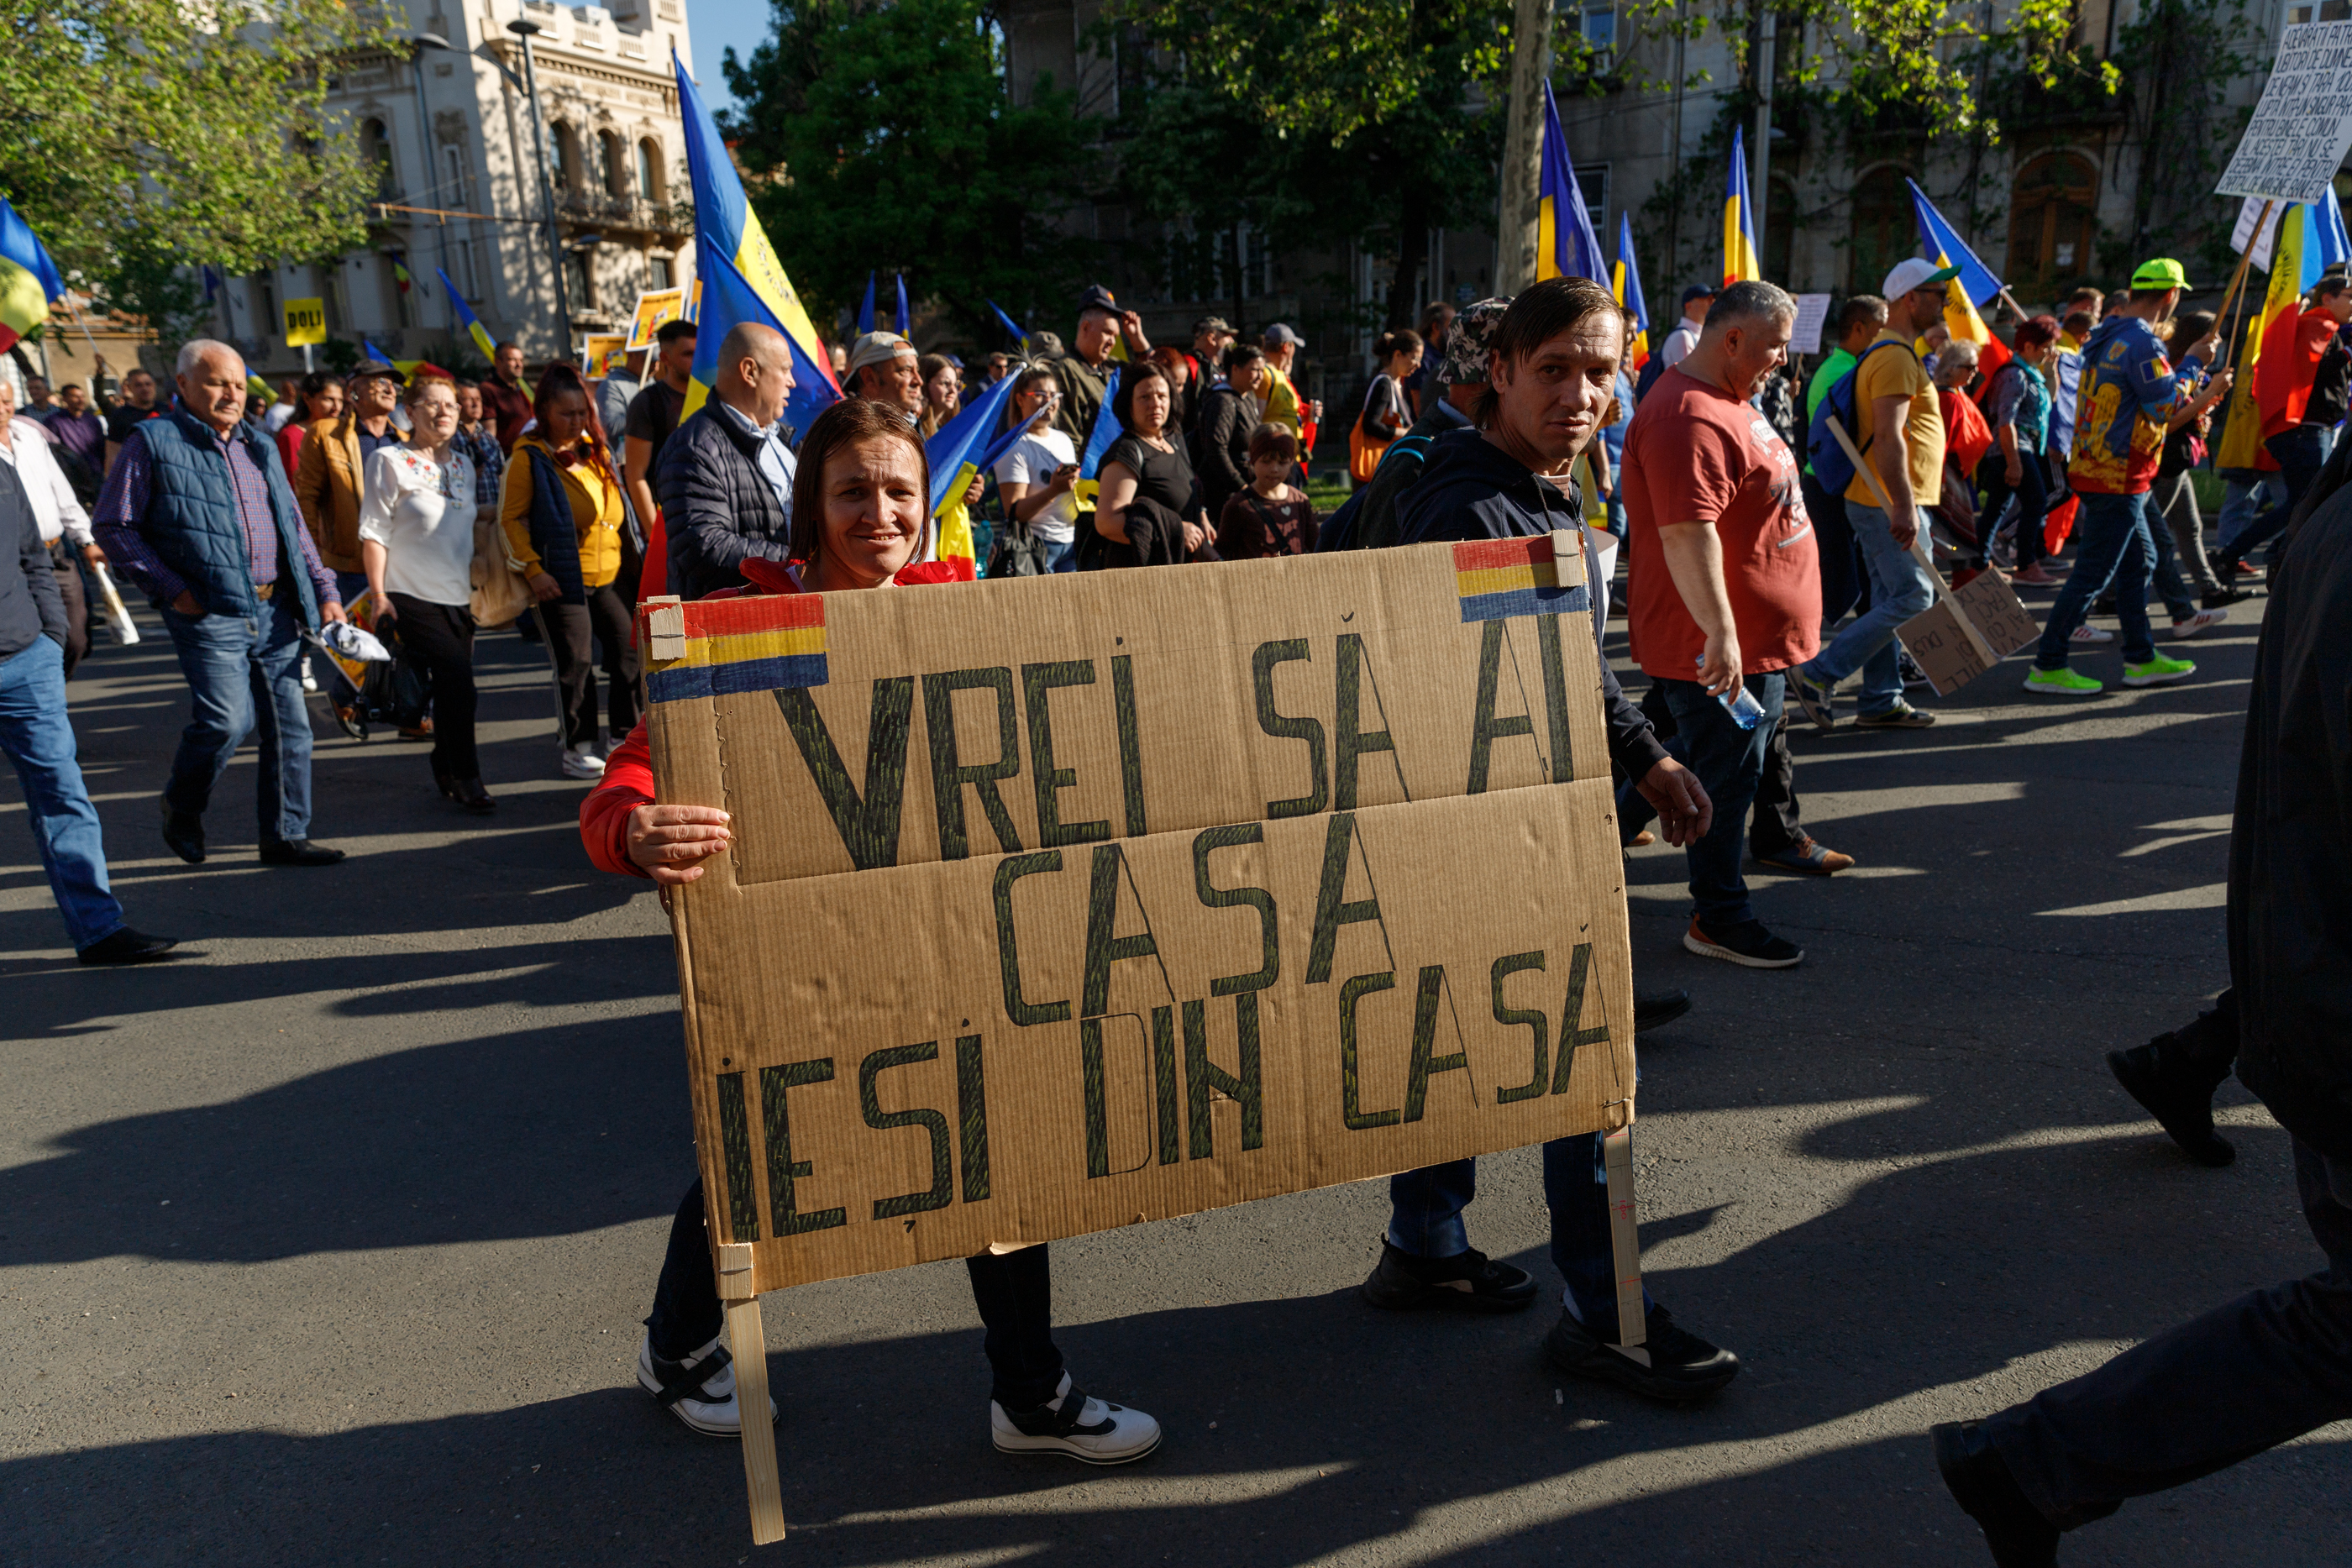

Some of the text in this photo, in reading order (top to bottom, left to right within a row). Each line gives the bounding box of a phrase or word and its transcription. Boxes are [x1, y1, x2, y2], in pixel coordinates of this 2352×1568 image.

[2307, 49, 2323, 70] DE
[2265, 76, 2281, 97] DE
[2306, 117, 2341, 137] COMUN
[2319, 138, 2338, 158] SE
[2296, 159, 2340, 179] PENTRU
[288, 310, 321, 328] DOLJ
[1467, 613, 1574, 795] AI
[993, 812, 1396, 1026] CASA
[1081, 991, 1263, 1178] DIN
[1340, 924, 1619, 1130] CASĂ
